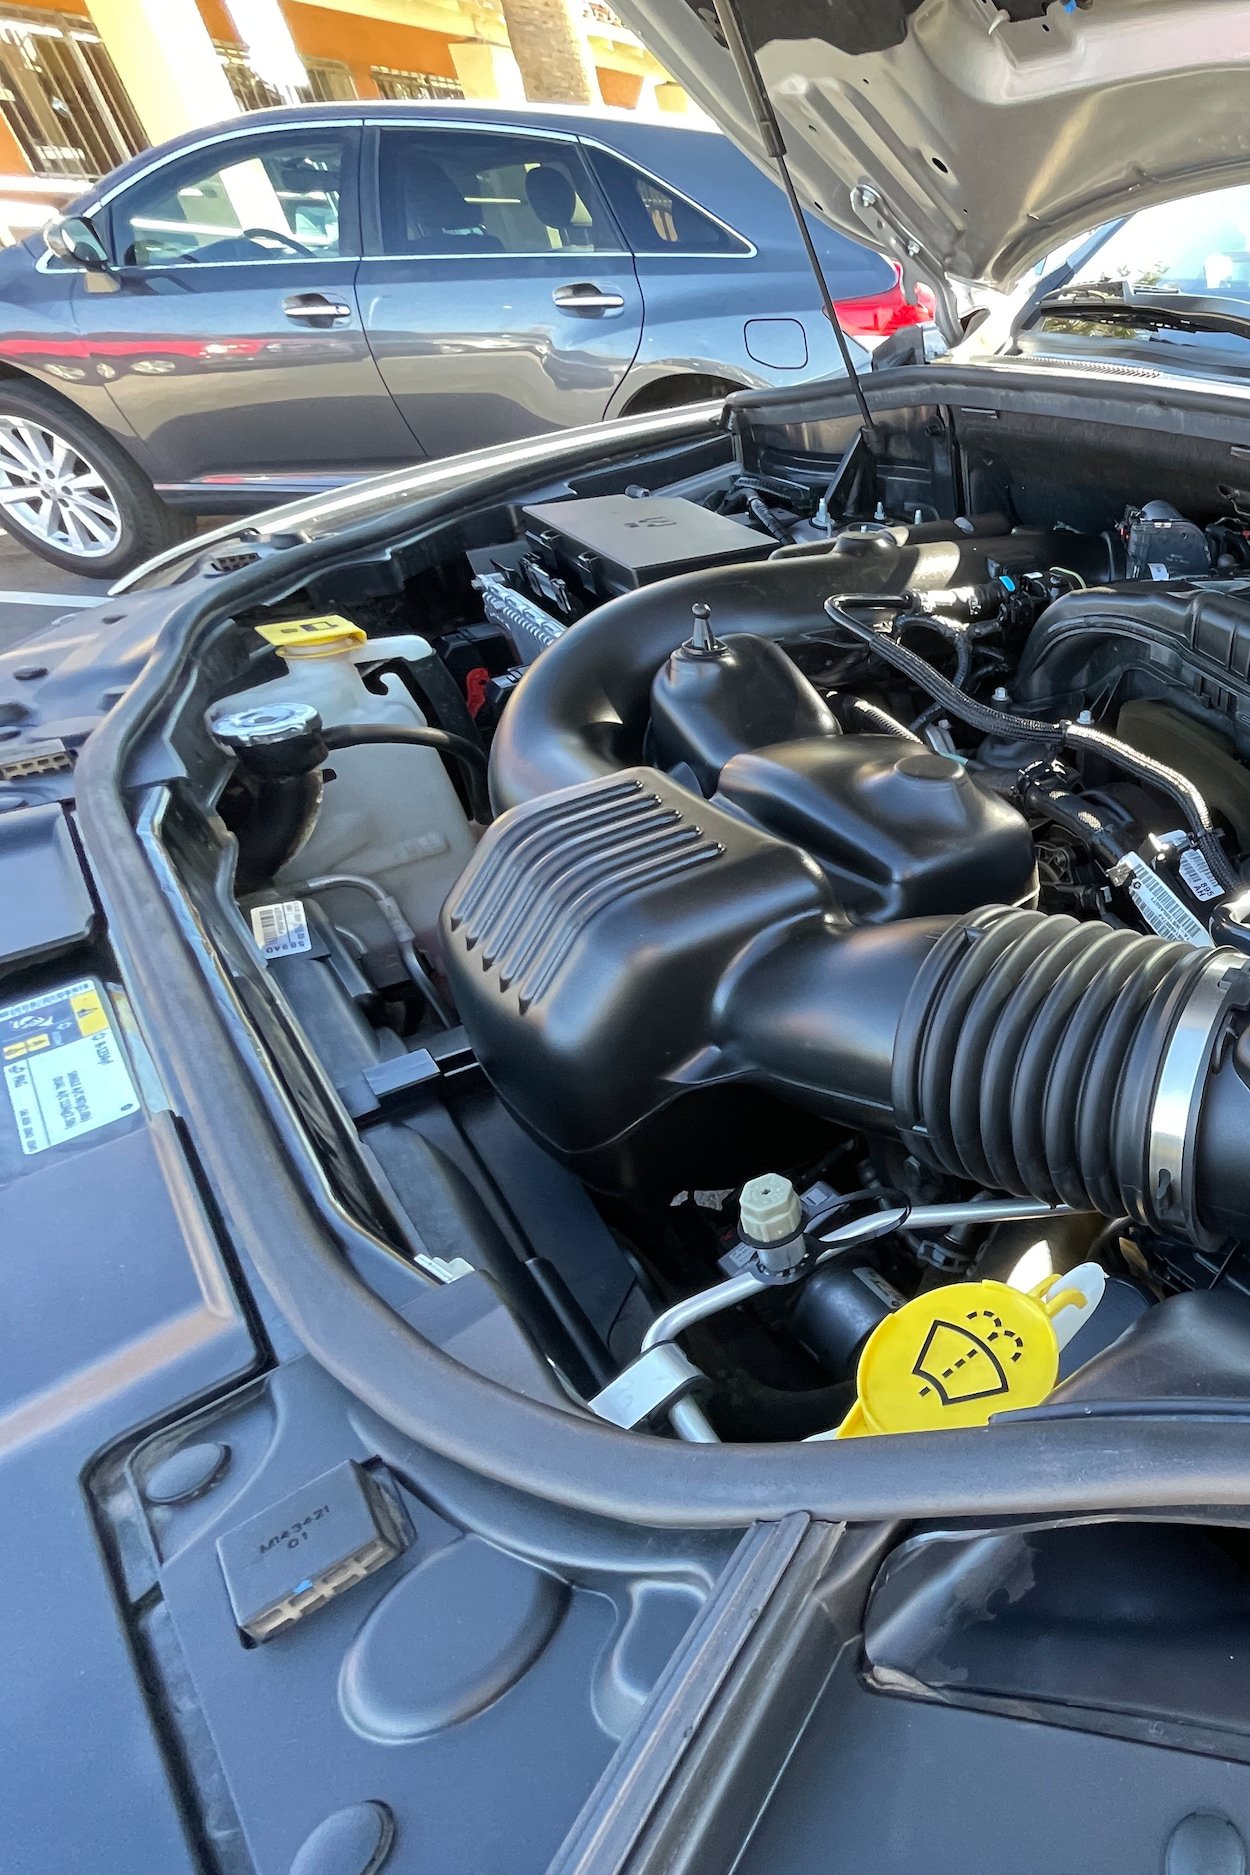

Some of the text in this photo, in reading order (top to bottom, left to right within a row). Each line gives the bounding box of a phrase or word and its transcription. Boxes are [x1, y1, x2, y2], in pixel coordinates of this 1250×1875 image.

[1193, 885, 1206, 898] AH
[1200, 882, 1214, 897] 895
[259, 1505, 331, 1554] M143421
[286, 1532, 309, 1550] 01
